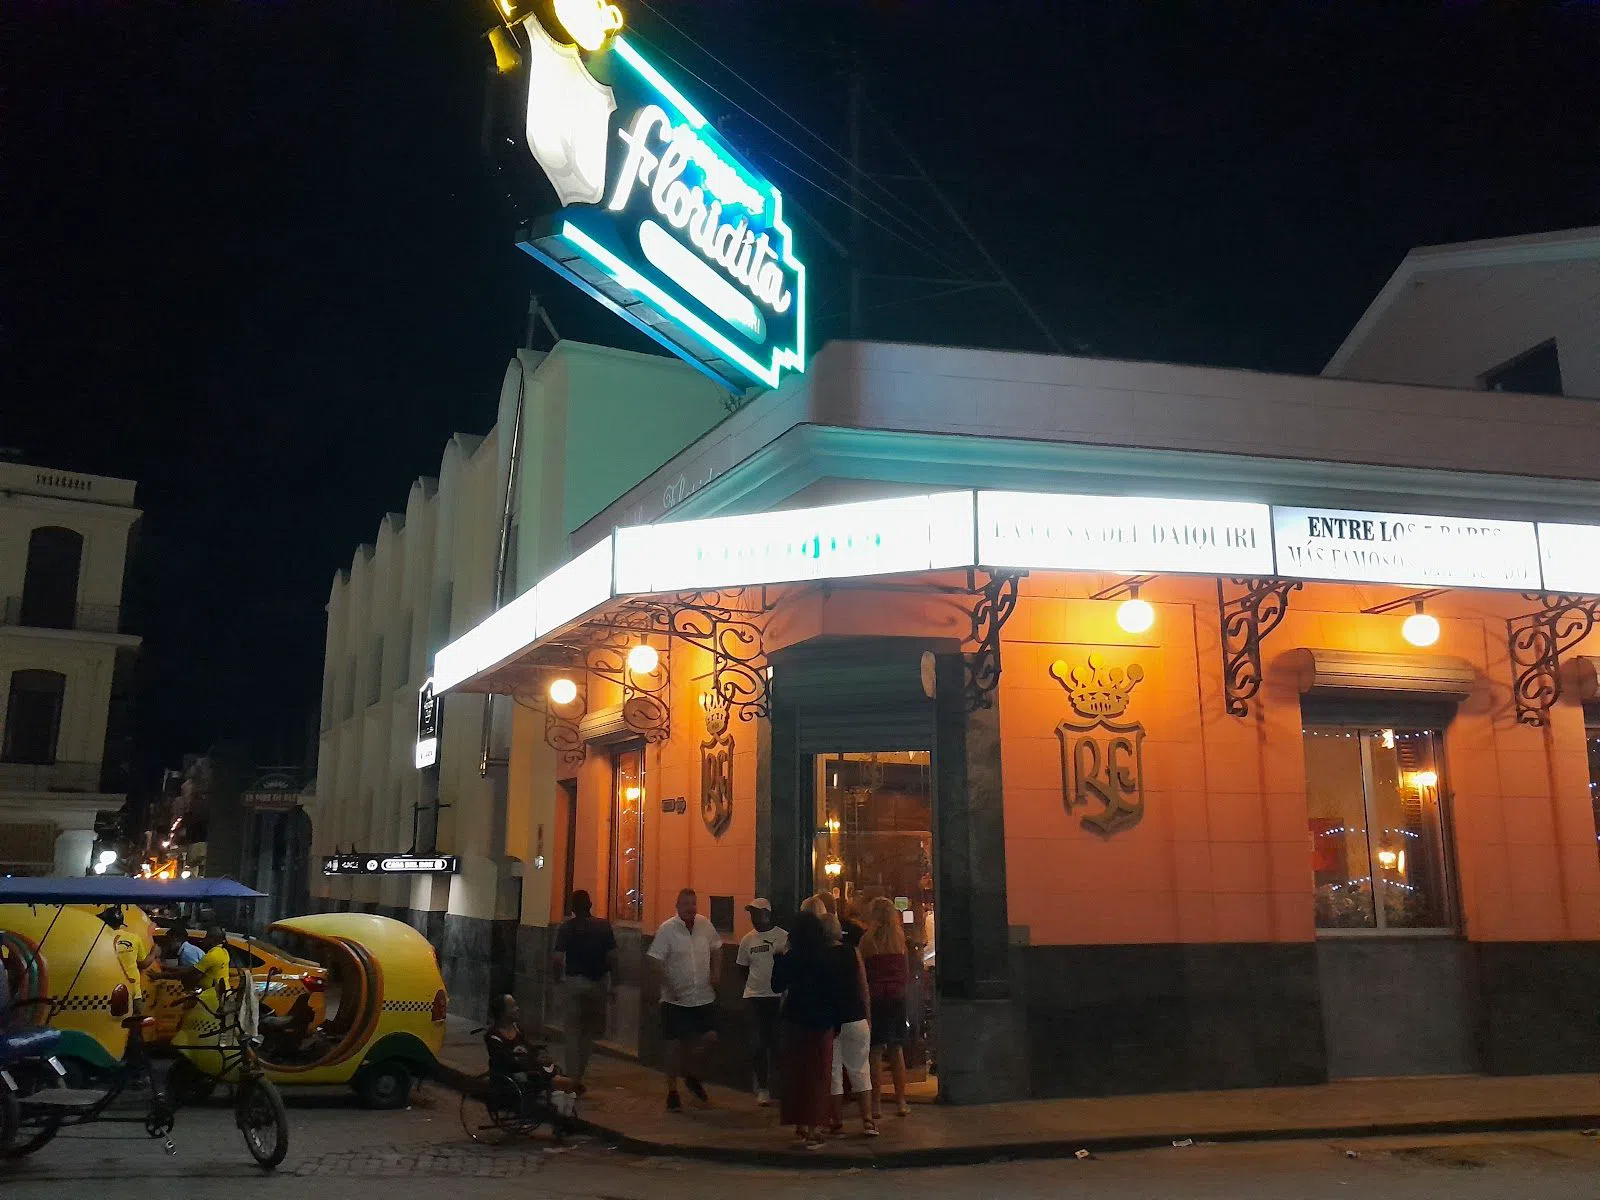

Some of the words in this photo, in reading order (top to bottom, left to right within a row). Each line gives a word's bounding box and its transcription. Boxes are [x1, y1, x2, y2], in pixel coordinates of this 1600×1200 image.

[1307, 516, 1375, 541] ENTRE
[1380, 520, 1416, 543] LOS
[1331, 547, 1417, 573] FAMOSO
